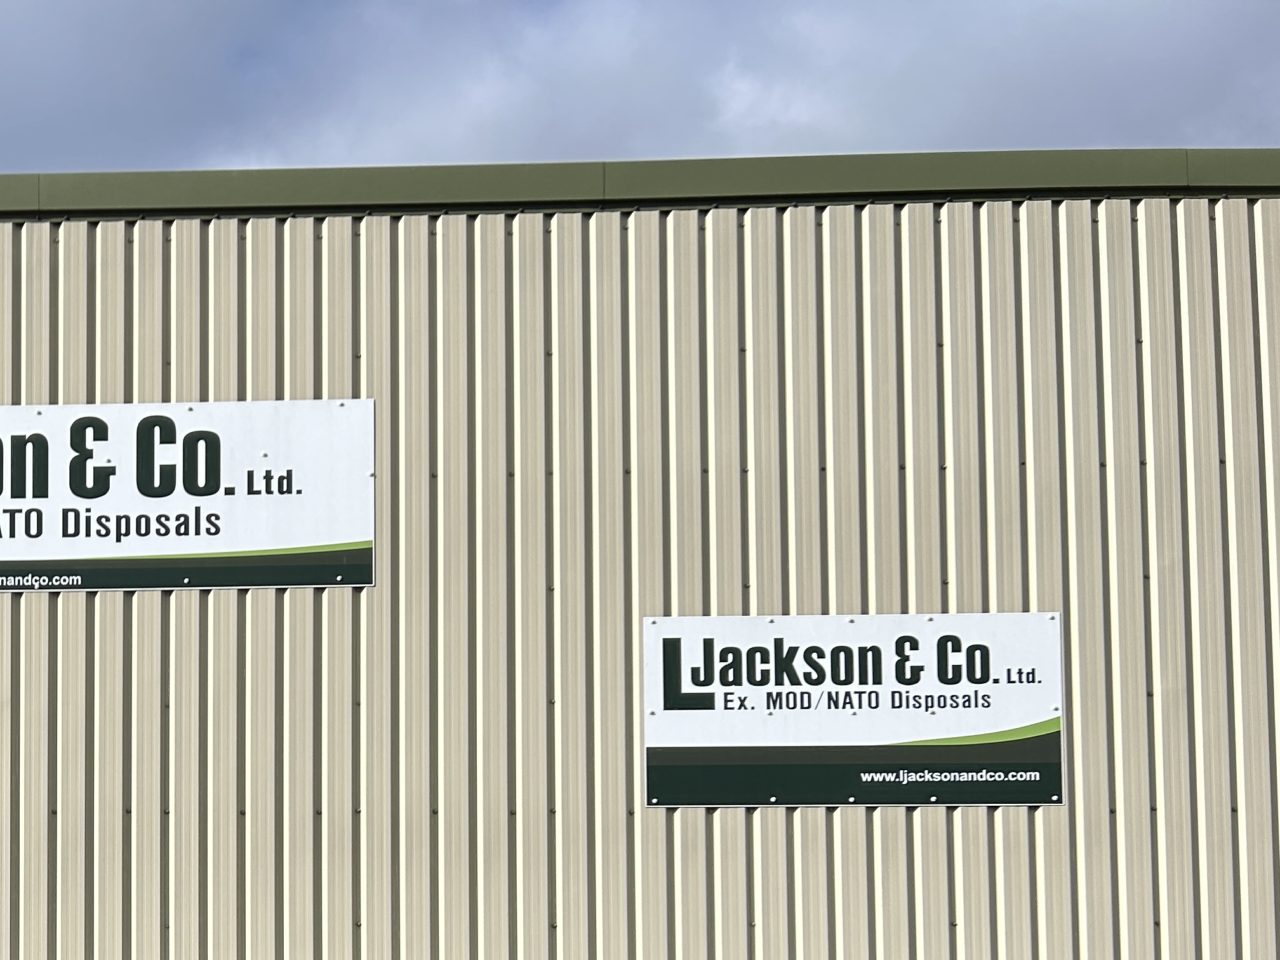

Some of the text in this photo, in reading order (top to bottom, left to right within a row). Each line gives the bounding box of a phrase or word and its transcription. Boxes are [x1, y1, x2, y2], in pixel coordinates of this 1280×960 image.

[68, 415, 118, 500] &
[135, 415, 237, 499] Co.
[246, 468, 304, 497] Ltd.
[61, 505, 222, 543] Disposals
[894, 635, 926, 686] &
[936, 634, 1001, 686] Co.
[1006, 667, 1043, 685] Ltd.
[723, 688, 992, 713] Ex. MOD/NATO Disposals
[860, 768, 1041, 785] www.ljacksonandco.com
